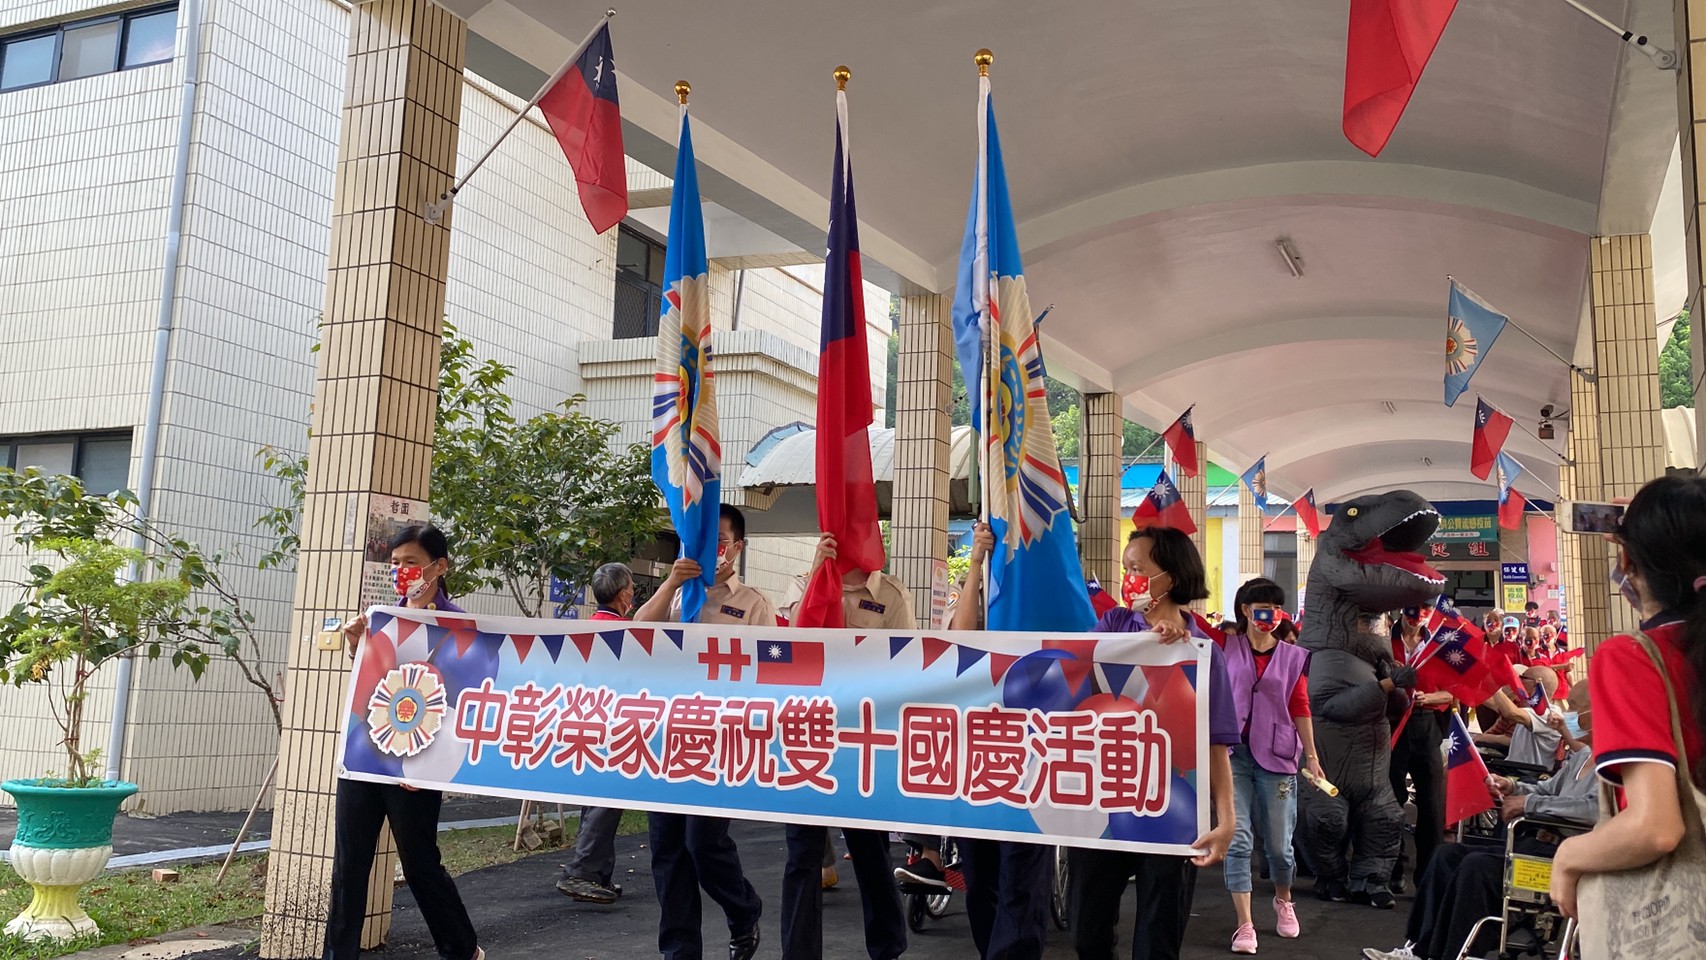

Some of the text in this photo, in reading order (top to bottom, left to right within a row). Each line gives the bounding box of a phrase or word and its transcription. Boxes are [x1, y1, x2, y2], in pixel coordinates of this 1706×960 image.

[456, 679, 1171, 816] 中彰榮家慶祝雙十國慶活動
